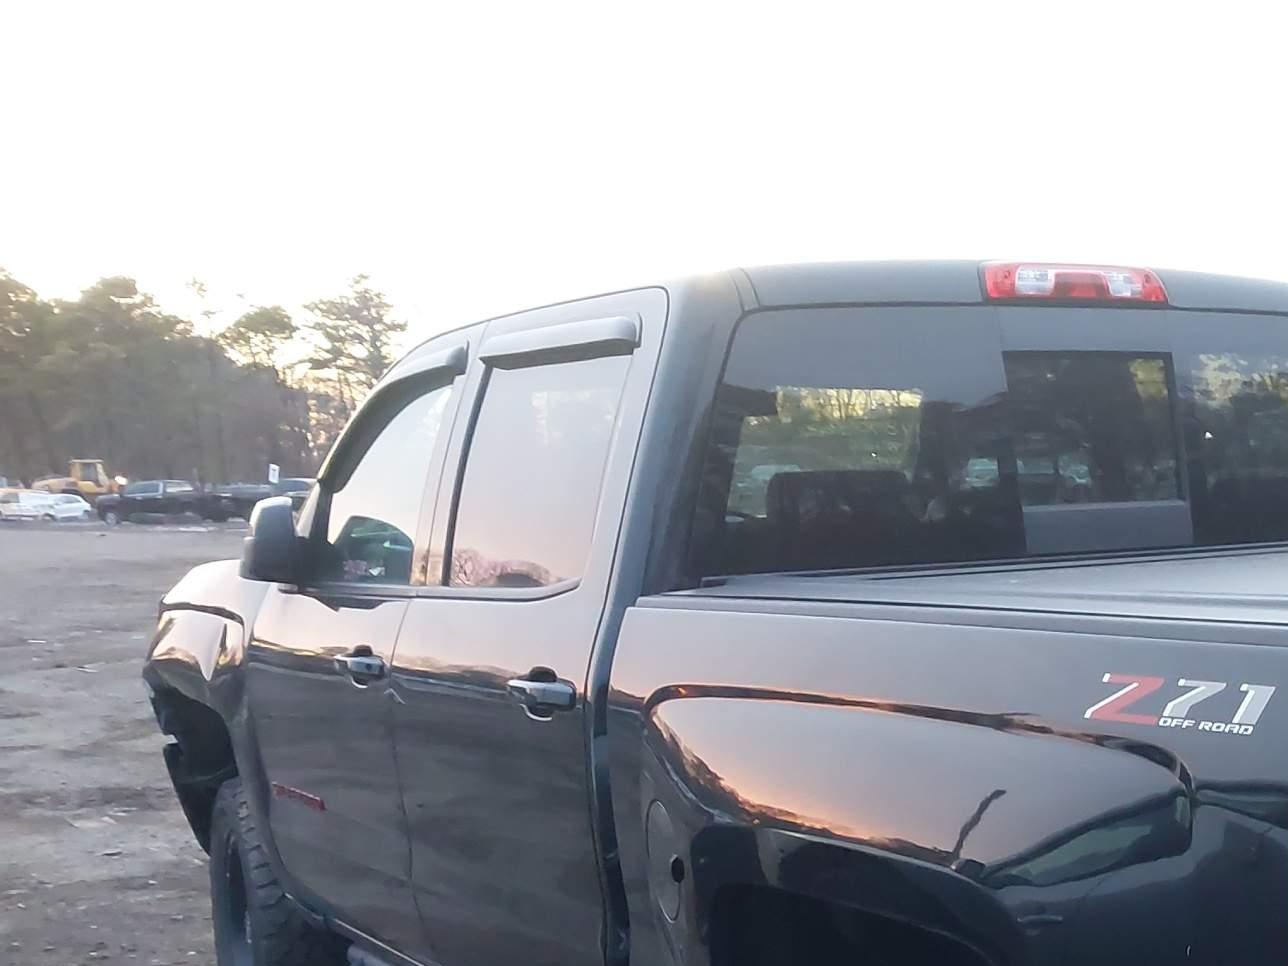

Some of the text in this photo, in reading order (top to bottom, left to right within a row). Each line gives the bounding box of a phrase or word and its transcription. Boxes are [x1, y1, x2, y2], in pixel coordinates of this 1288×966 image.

[1084, 673, 1276, 726] Z71
[1158, 717, 1255, 736] OFF ROAD
